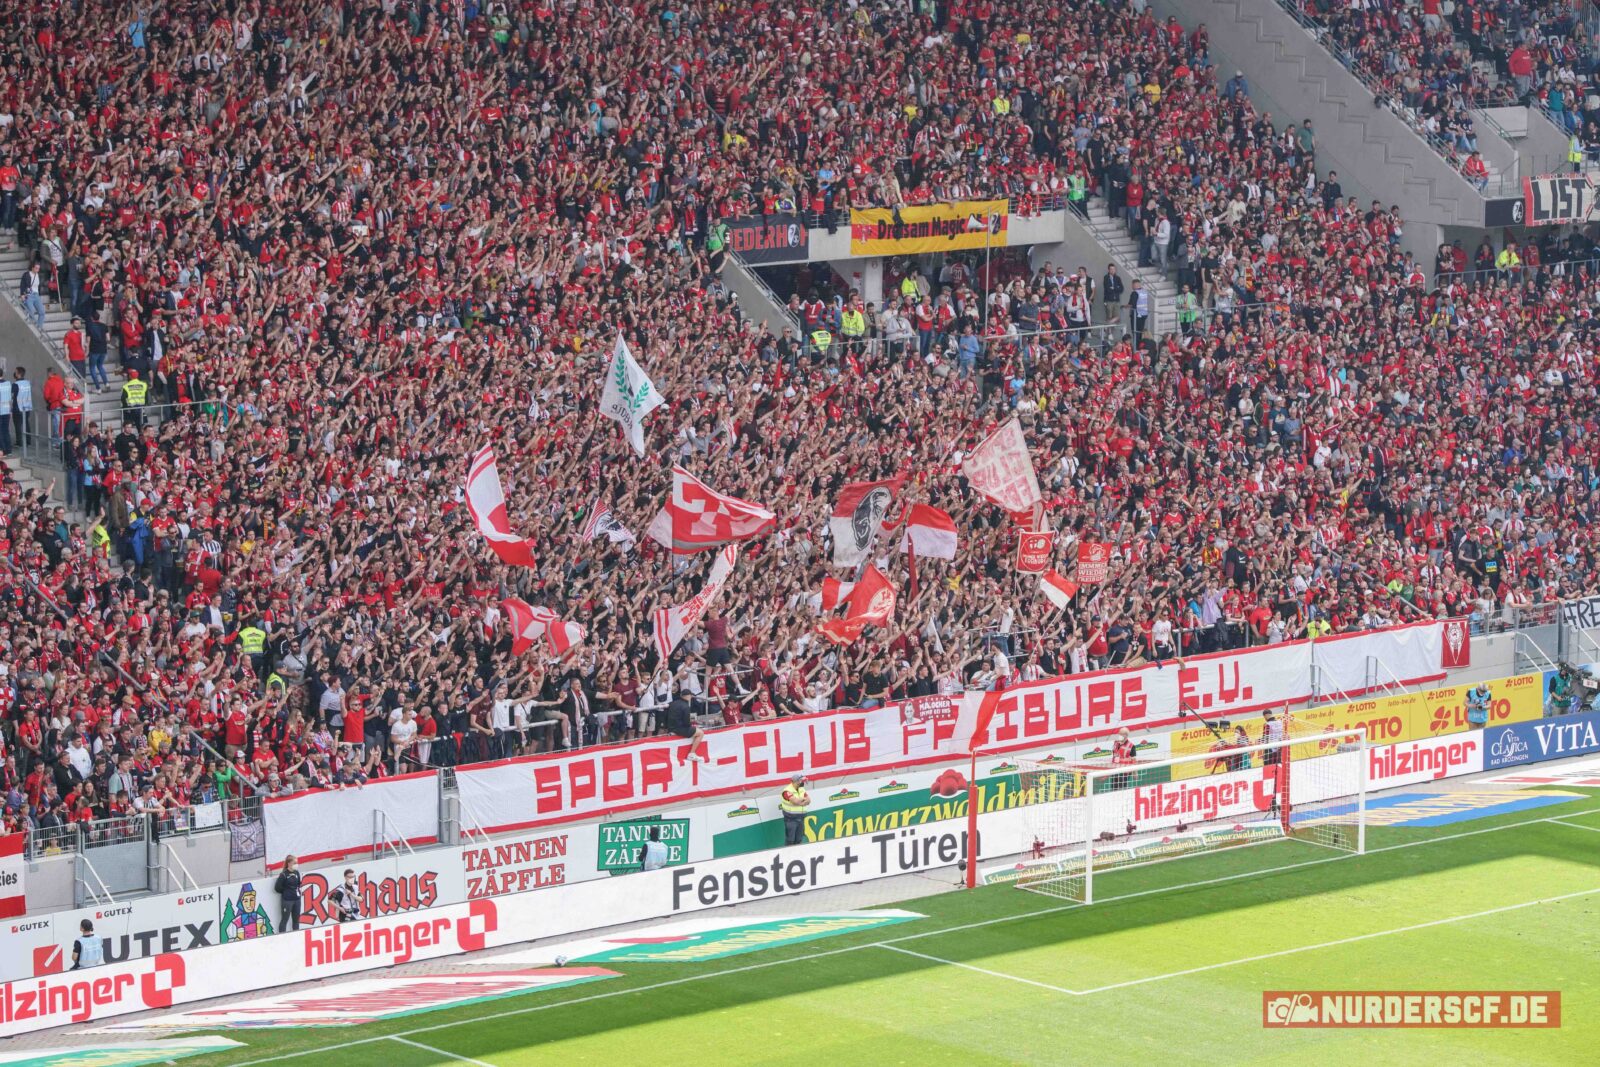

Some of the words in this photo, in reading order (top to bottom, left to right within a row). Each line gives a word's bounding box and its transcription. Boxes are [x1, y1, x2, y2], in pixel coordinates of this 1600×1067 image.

[932, 214, 966, 240] Magic
[1435, 688, 1456, 698] LOTTO
[1513, 676, 1534, 686] LOTTO
[1355, 702, 1376, 712] LOTTO
[1454, 698, 1511, 727] LTO
[1189, 730, 1212, 740] LOTTO
[1534, 721, 1600, 756] VITA
[534, 718, 871, 814] SPORT-CLUB
[1369, 741, 1476, 780] hilzinger
[1134, 778, 1249, 822] hilzinger
[462, 835, 568, 872] TANNEN
[467, 863, 566, 900] ZÄPFLE
[673, 854, 824, 911] Fenster
[836, 846, 859, 875] +
[104, 906, 133, 918] GUTEX
[185, 893, 214, 904] GUTEX
[19, 920, 49, 932] GUTEX
[102, 920, 214, 964] UTEX
[305, 918, 451, 967] hilzinger
